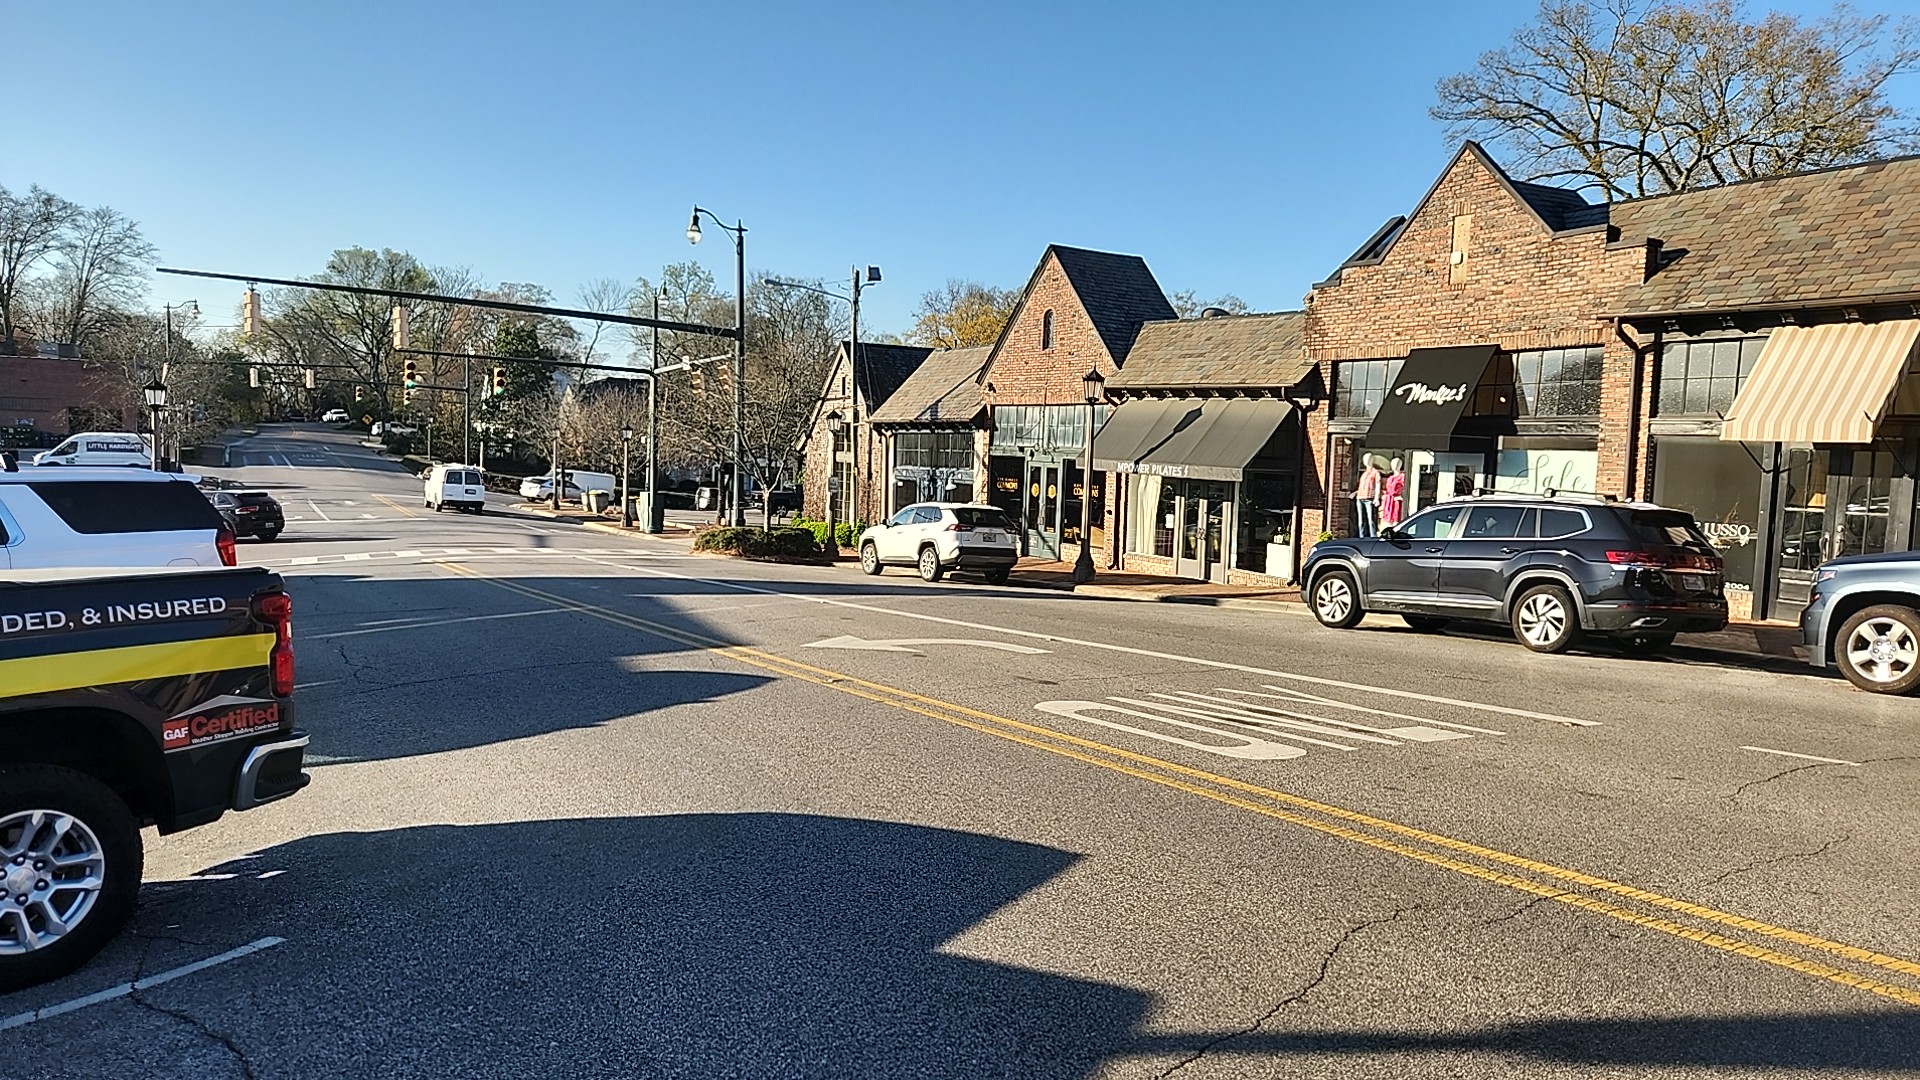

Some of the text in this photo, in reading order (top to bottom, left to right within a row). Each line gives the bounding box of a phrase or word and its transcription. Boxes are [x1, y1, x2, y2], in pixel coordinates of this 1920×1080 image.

[1152, 464, 1182, 477] PILATES
[1704, 522, 1751, 537] LUSSO
[1724, 581, 1750, 591] 2004
[81, 607, 101, 625] &
[107, 596, 226, 623] INSURED
[190, 702, 279, 737] Certified
[1034, 684, 1506, 760] ONLY
[163, 726, 189, 741] GAF
